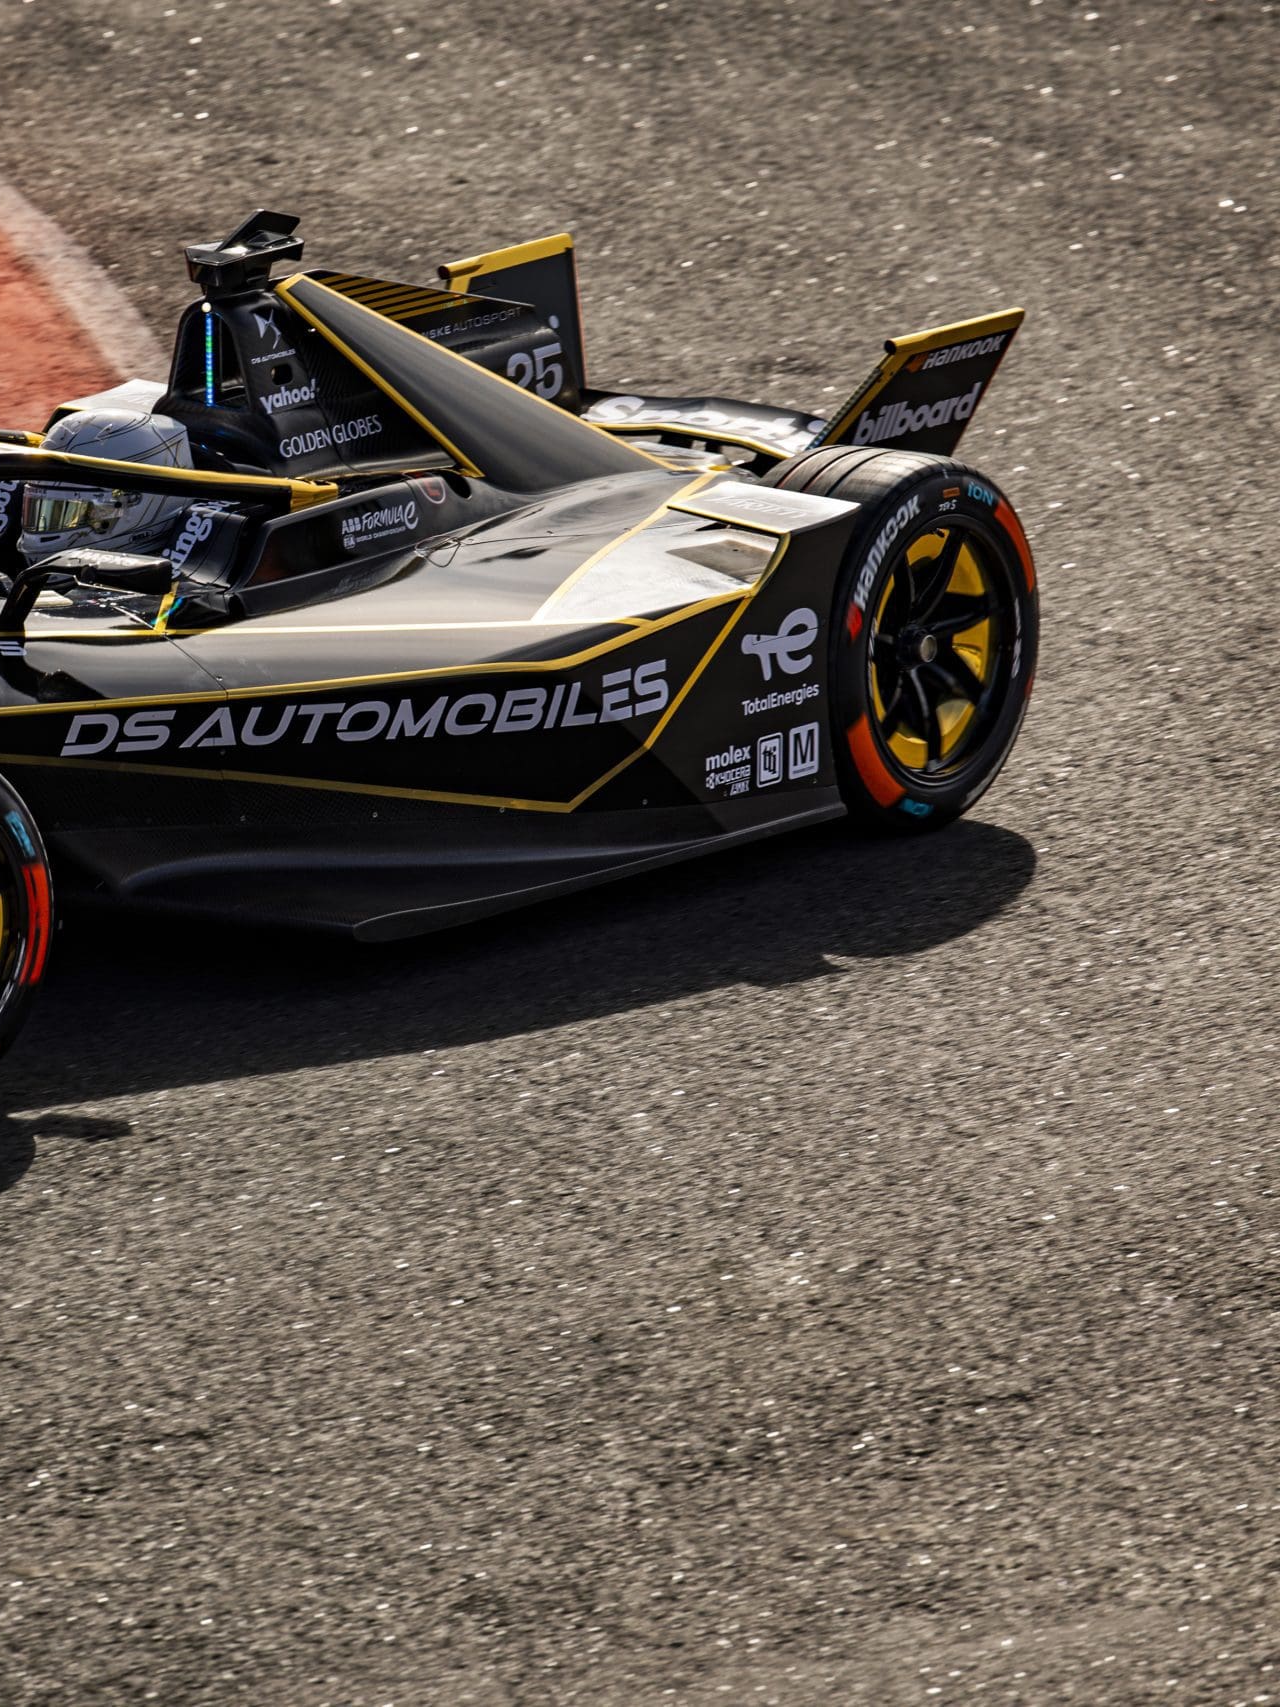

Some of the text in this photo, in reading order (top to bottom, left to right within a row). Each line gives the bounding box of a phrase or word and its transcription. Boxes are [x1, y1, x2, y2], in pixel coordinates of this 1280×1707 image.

[506, 342, 564, 400] 25
[259, 378, 316, 415] yahoo!
[851, 381, 983, 445] billboard
[279, 414, 383, 458] GOLDEN GLOBES
[341, 517, 362, 535] ABB
[60, 658, 668, 758] DS AUTOMOBILES
[741, 683, 820, 716] TotalEnergies
[705, 744, 751, 772] molex
